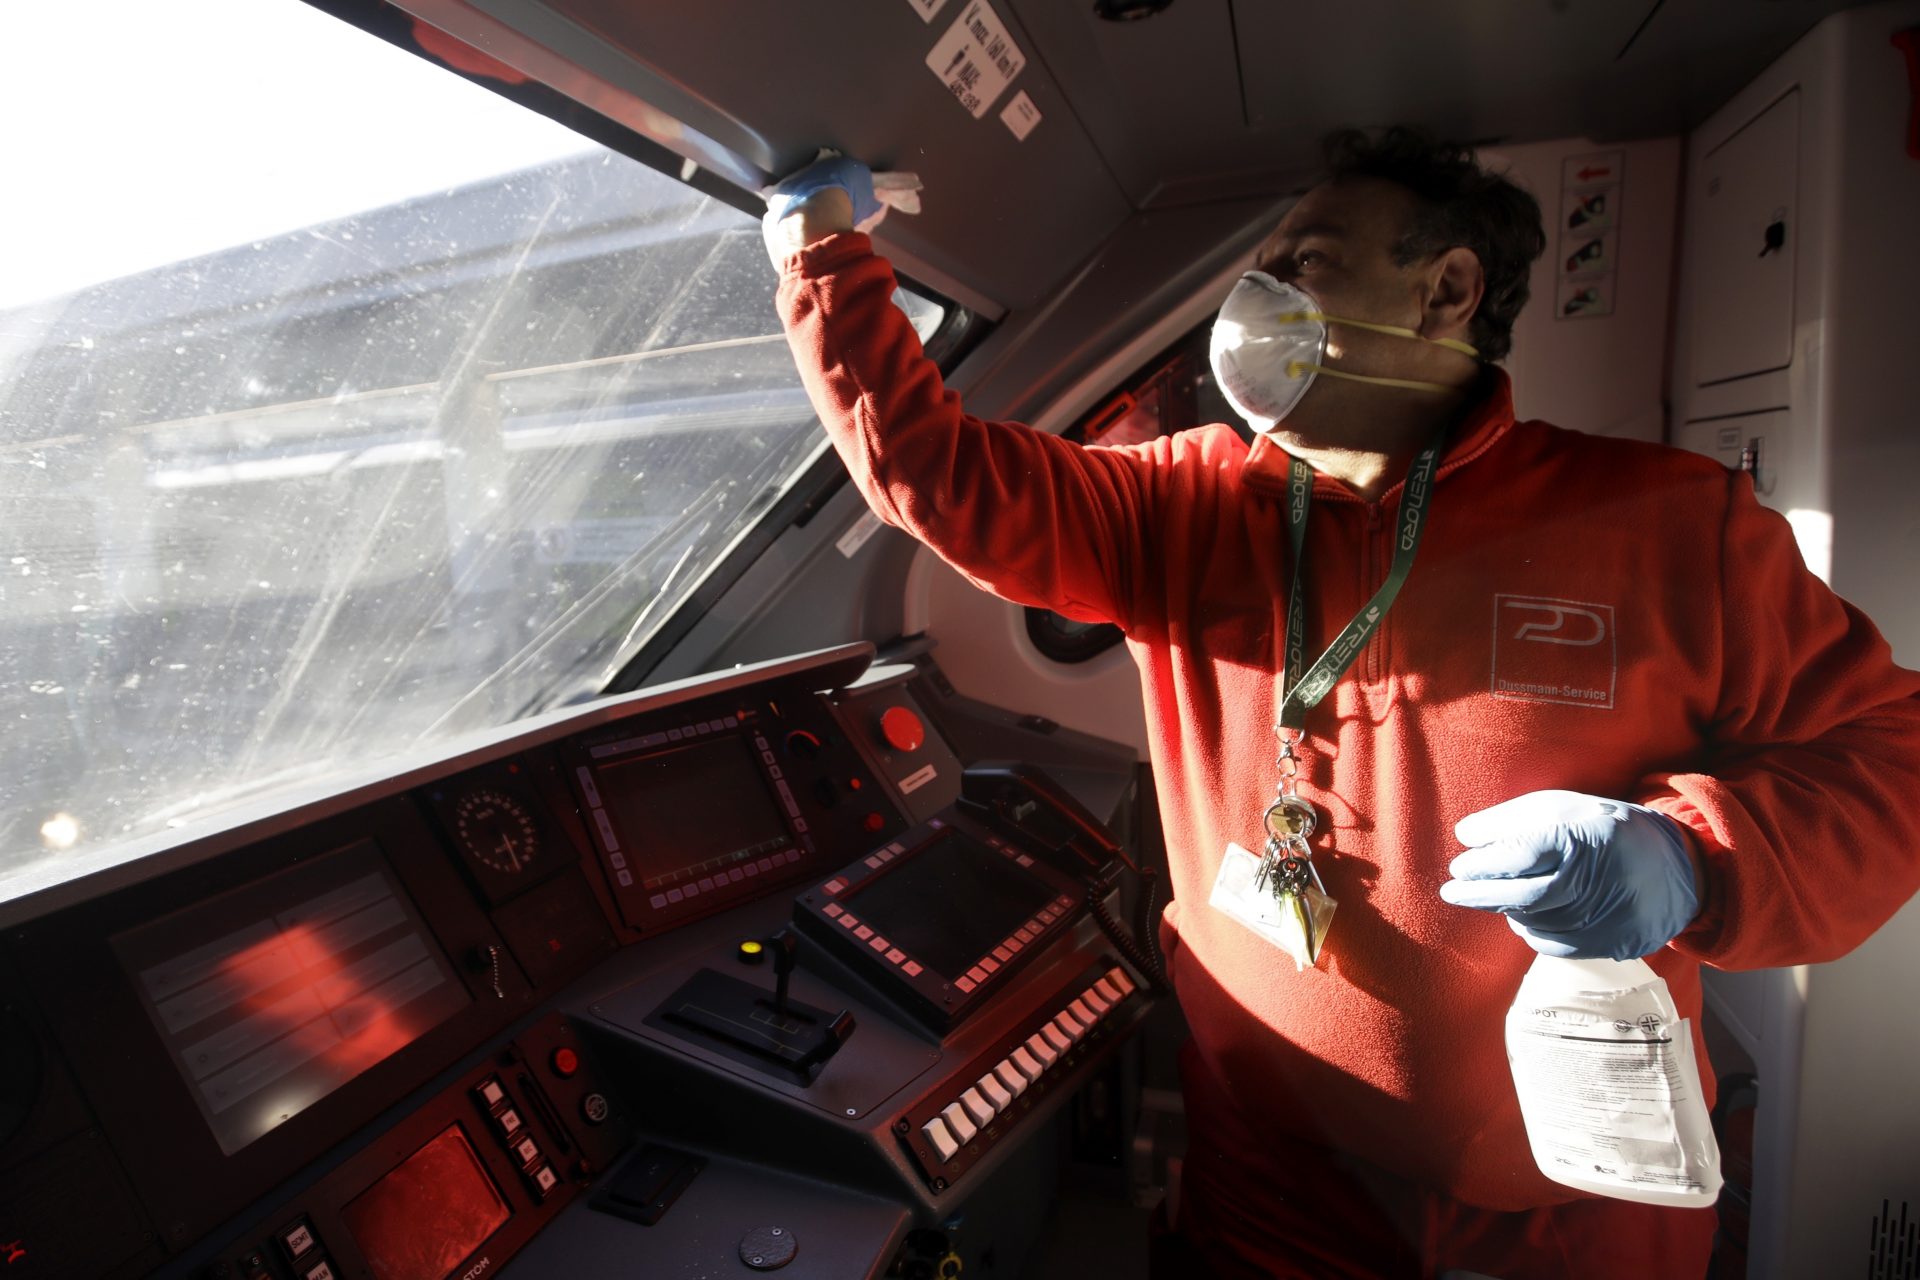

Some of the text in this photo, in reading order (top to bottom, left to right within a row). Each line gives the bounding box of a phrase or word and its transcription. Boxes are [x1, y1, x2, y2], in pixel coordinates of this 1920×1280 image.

[1401, 459, 1432, 551] TRENORD
[1498, 679, 1607, 701] Dussmann-Service
[291, 1231, 309, 1249] SCMT
